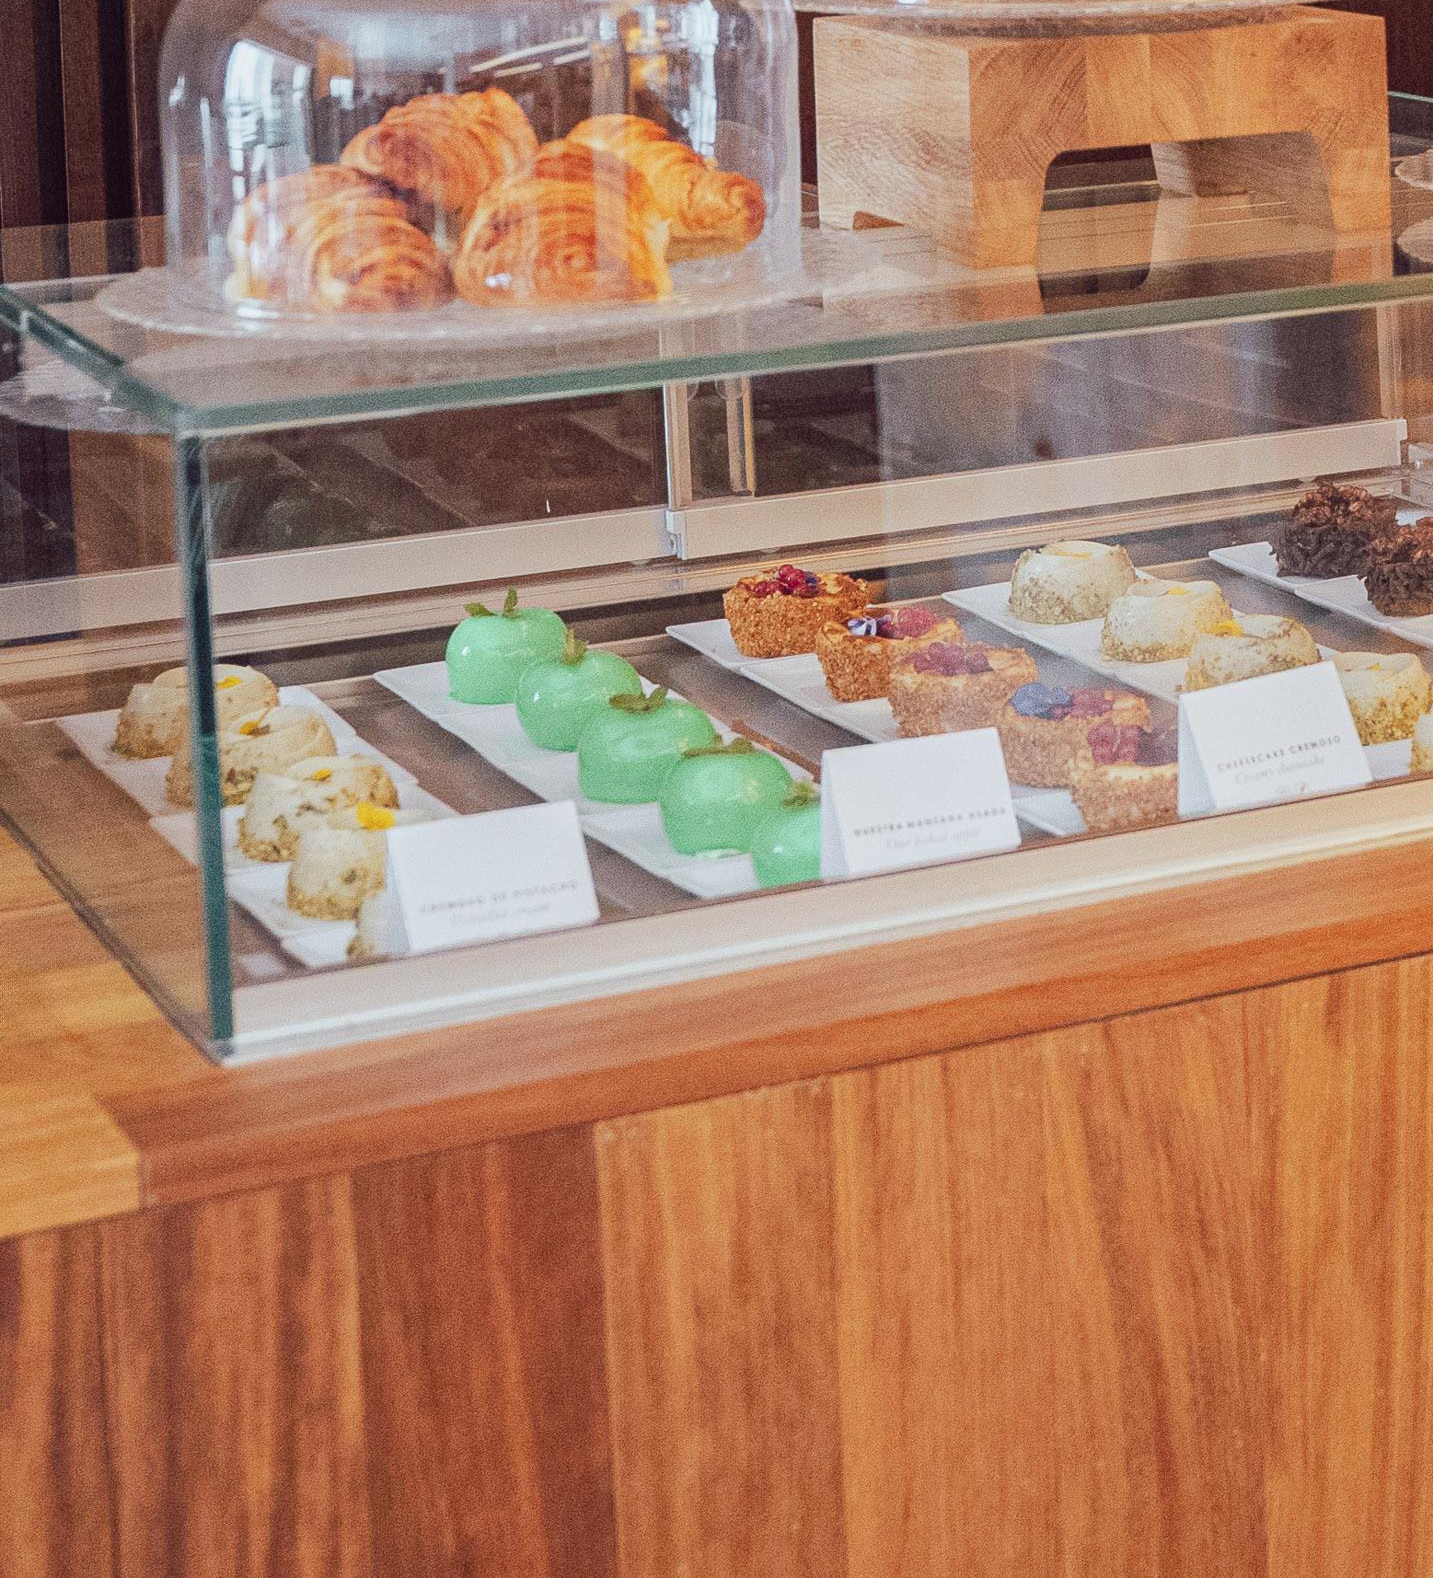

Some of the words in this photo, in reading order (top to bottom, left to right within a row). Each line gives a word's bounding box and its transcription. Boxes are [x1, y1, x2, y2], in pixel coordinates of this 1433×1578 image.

[1217, 749, 1285, 772] CHEESECAKE
[1288, 735, 1341, 754] CREMOSO
[906, 813, 963, 829] MANZANA
